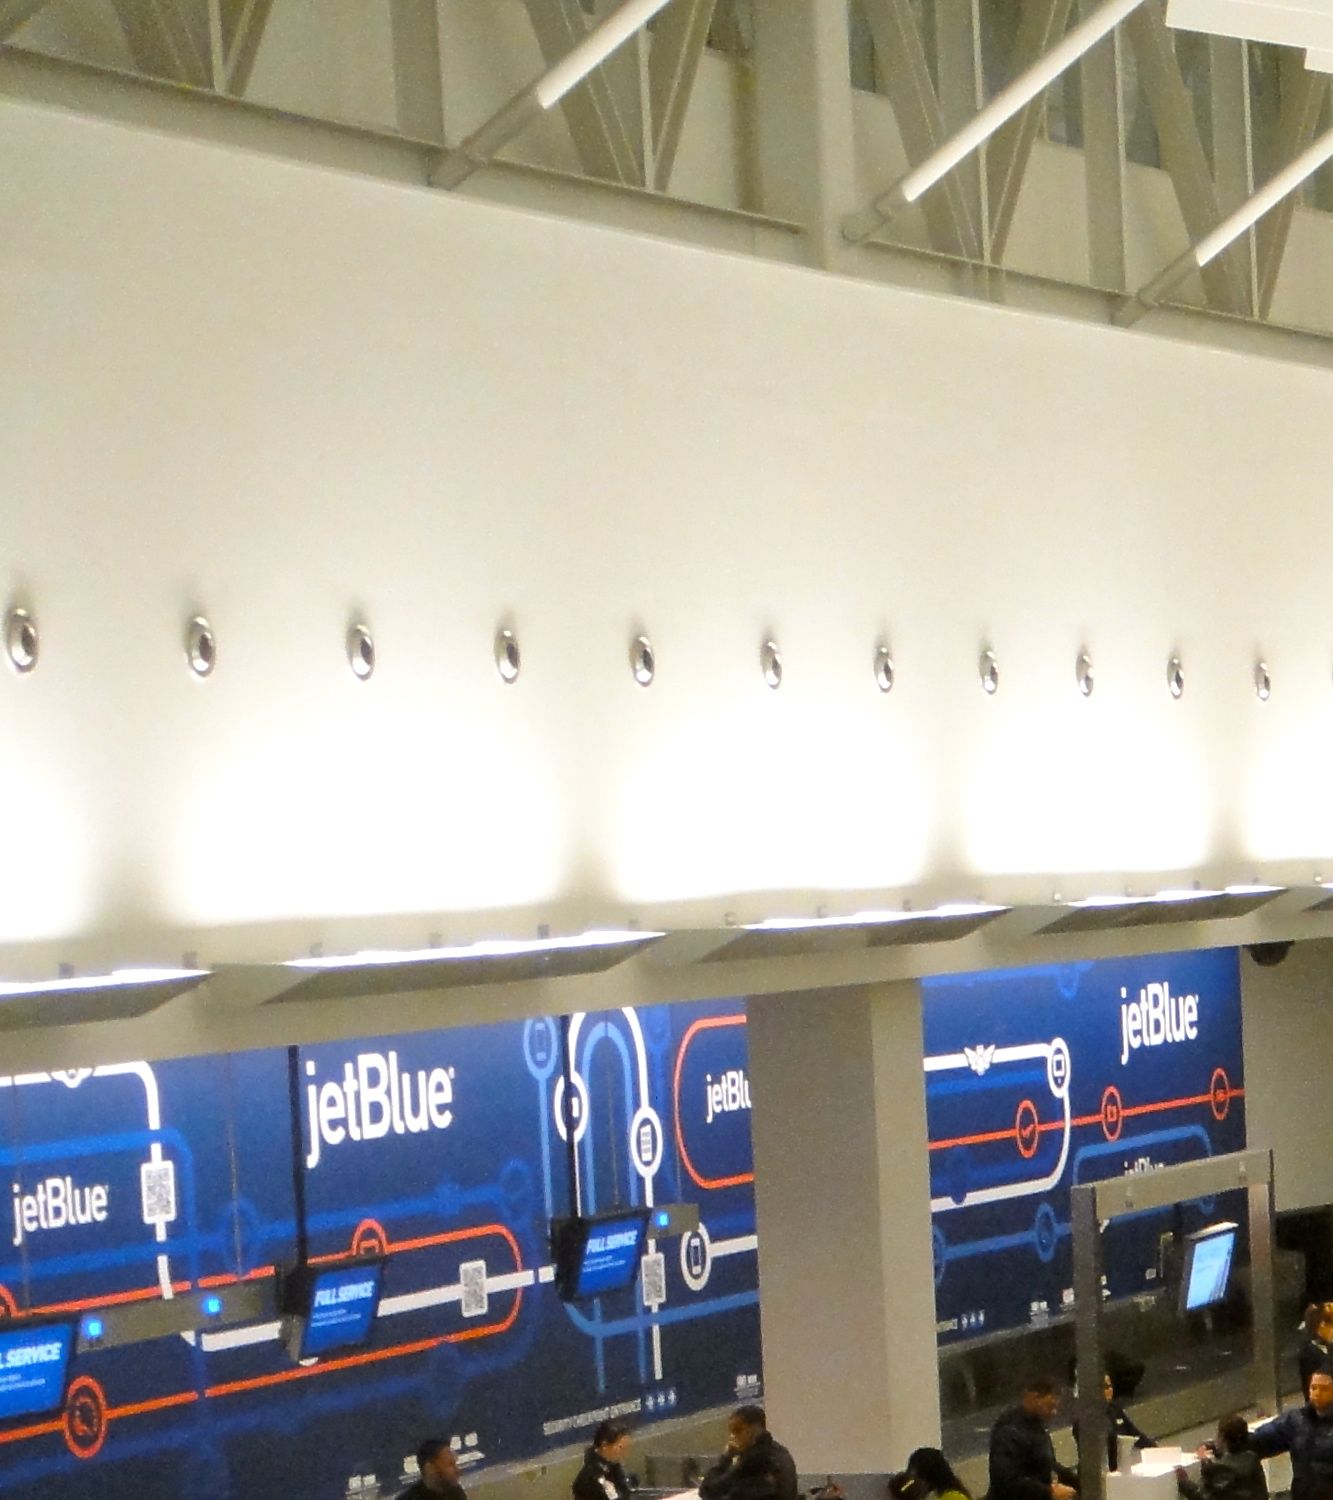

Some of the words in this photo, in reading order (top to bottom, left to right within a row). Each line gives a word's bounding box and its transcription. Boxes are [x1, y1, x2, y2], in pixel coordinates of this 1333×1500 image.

[1120, 982, 1198, 1064] jetBlue
[306, 1051, 453, 1168] jetBlue
[13, 1177, 108, 1246] jetBlue
